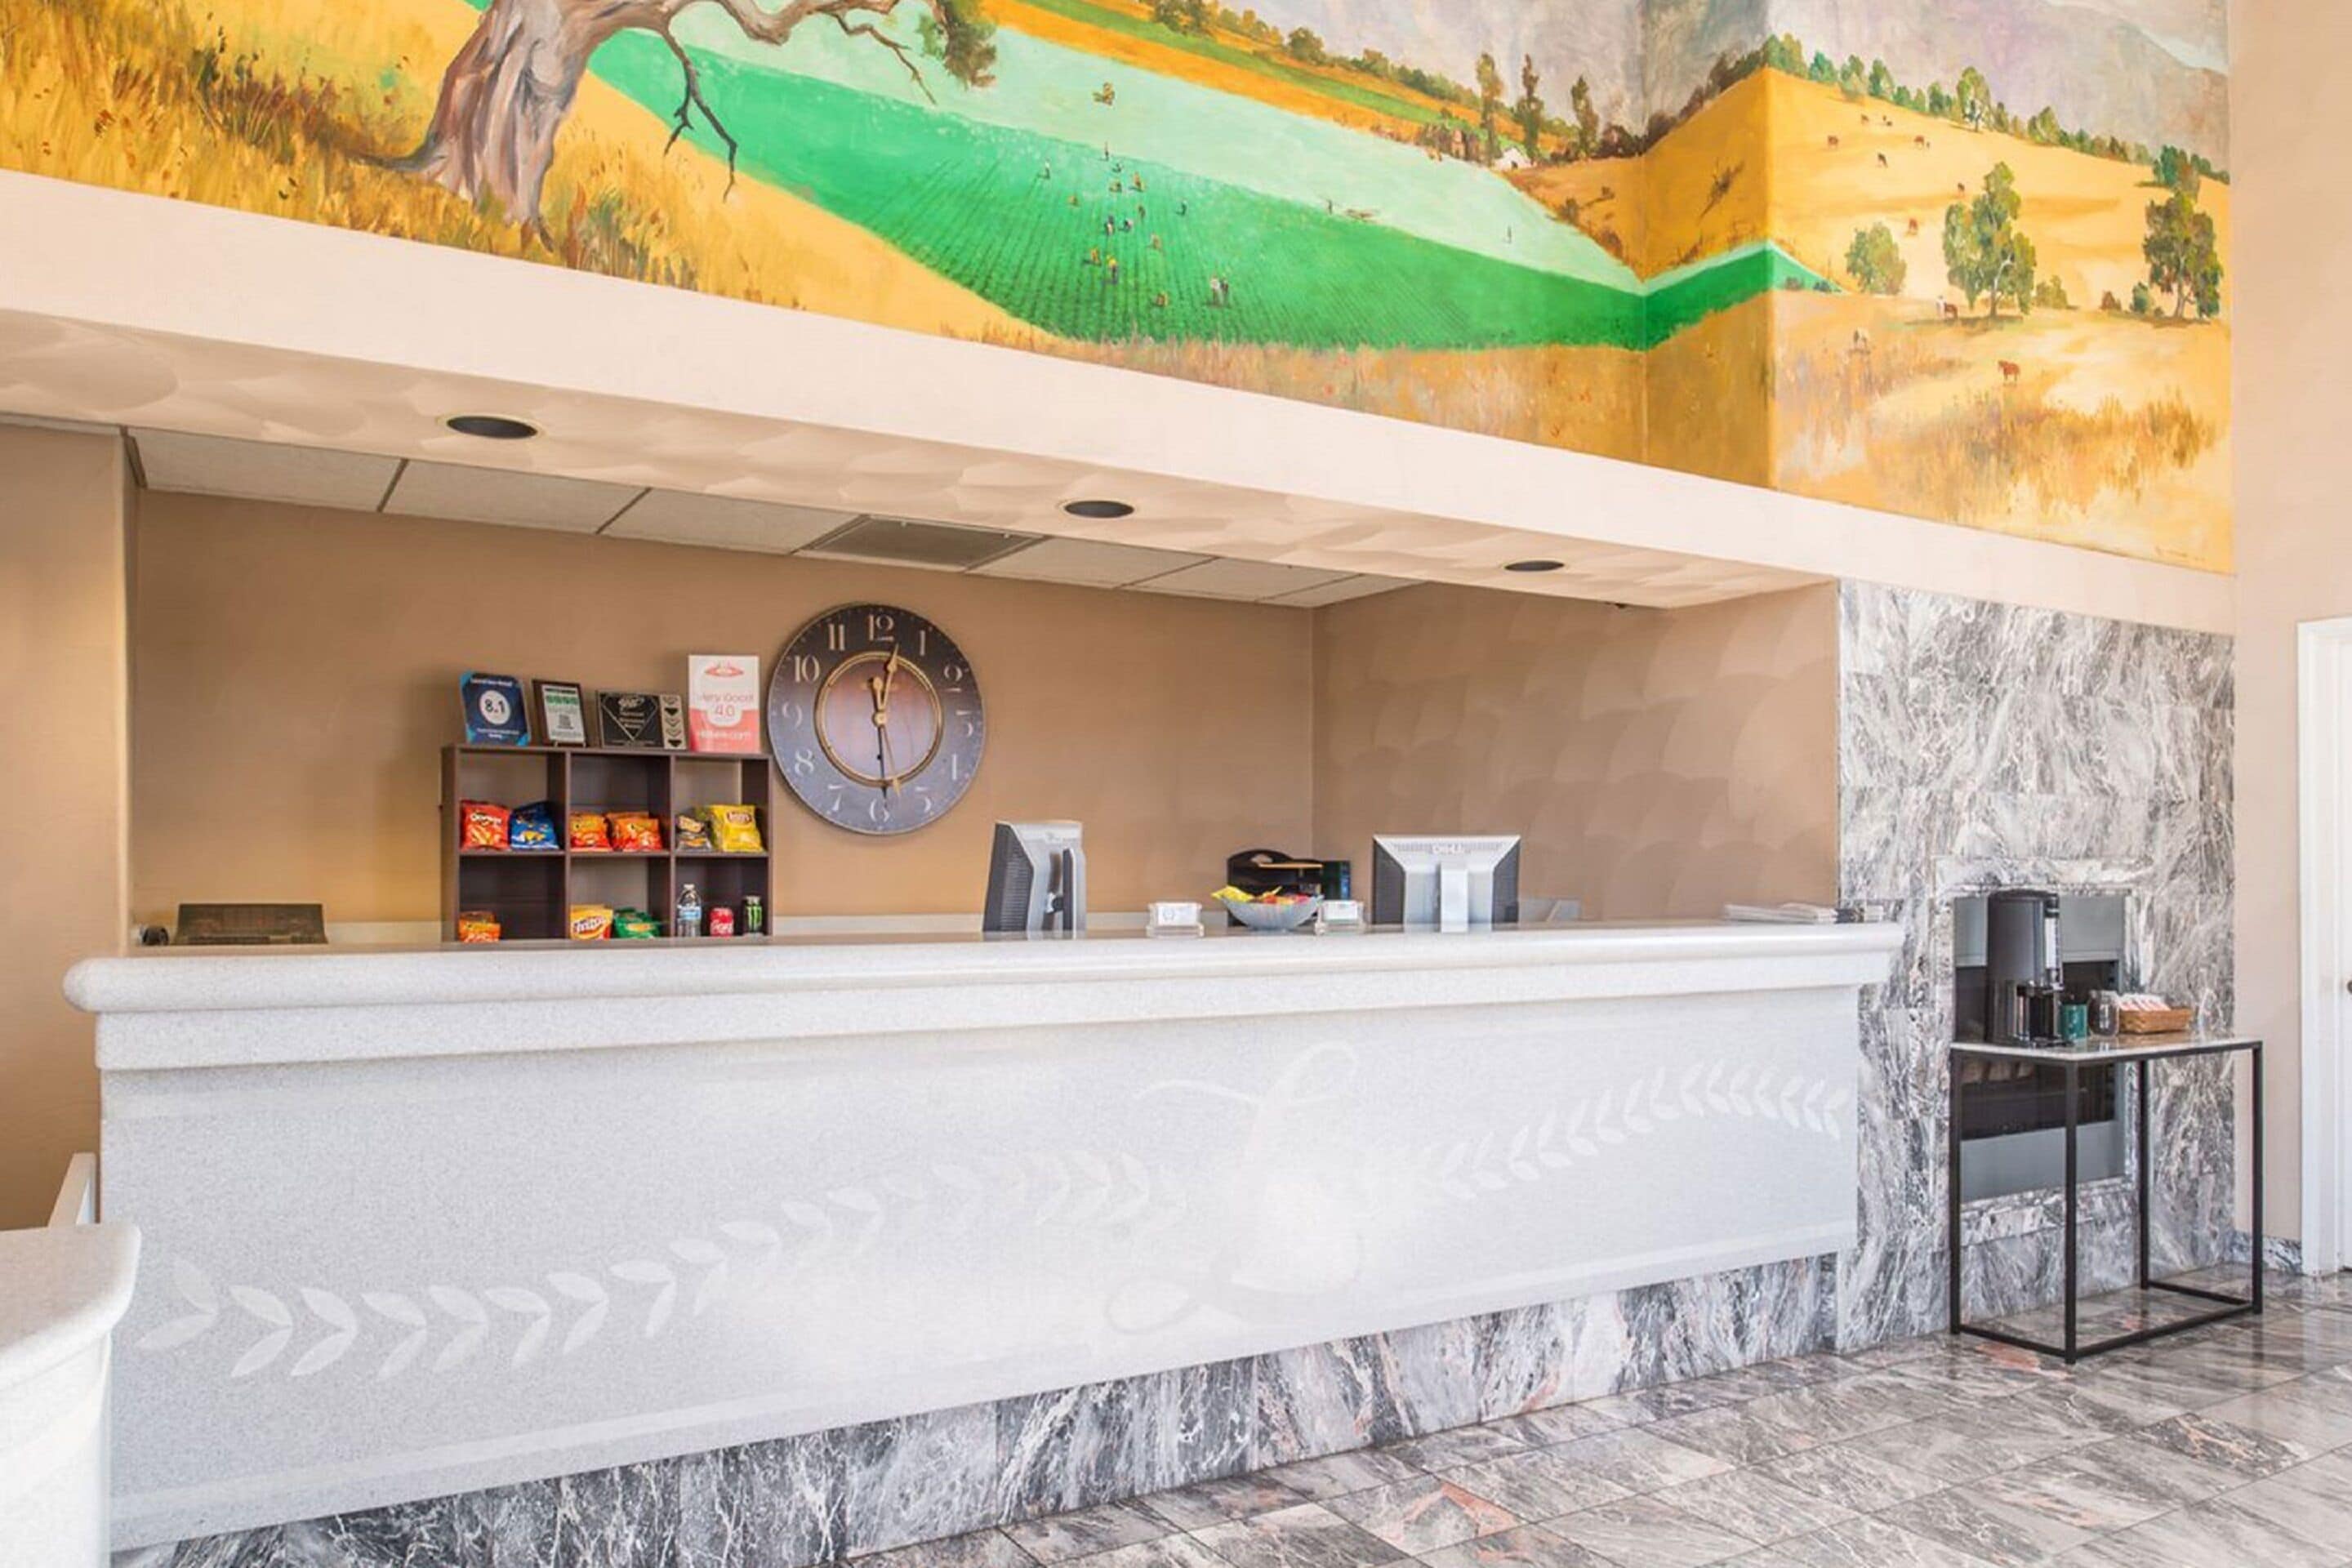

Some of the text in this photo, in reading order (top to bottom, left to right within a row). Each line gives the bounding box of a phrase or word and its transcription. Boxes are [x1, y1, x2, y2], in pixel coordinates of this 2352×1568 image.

[828, 624, 846, 651] 11
[868, 614, 895, 642] 12
[919, 630, 926, 656] 1
[794, 655, 820, 683] 10
[941, 665, 962, 693] 2
[483, 698, 506, 713] 8.1
[782, 702, 802, 726] 9
[795, 748, 814, 776] 8
[828, 784, 844, 812] 7
[869, 800, 891, 822] 6
